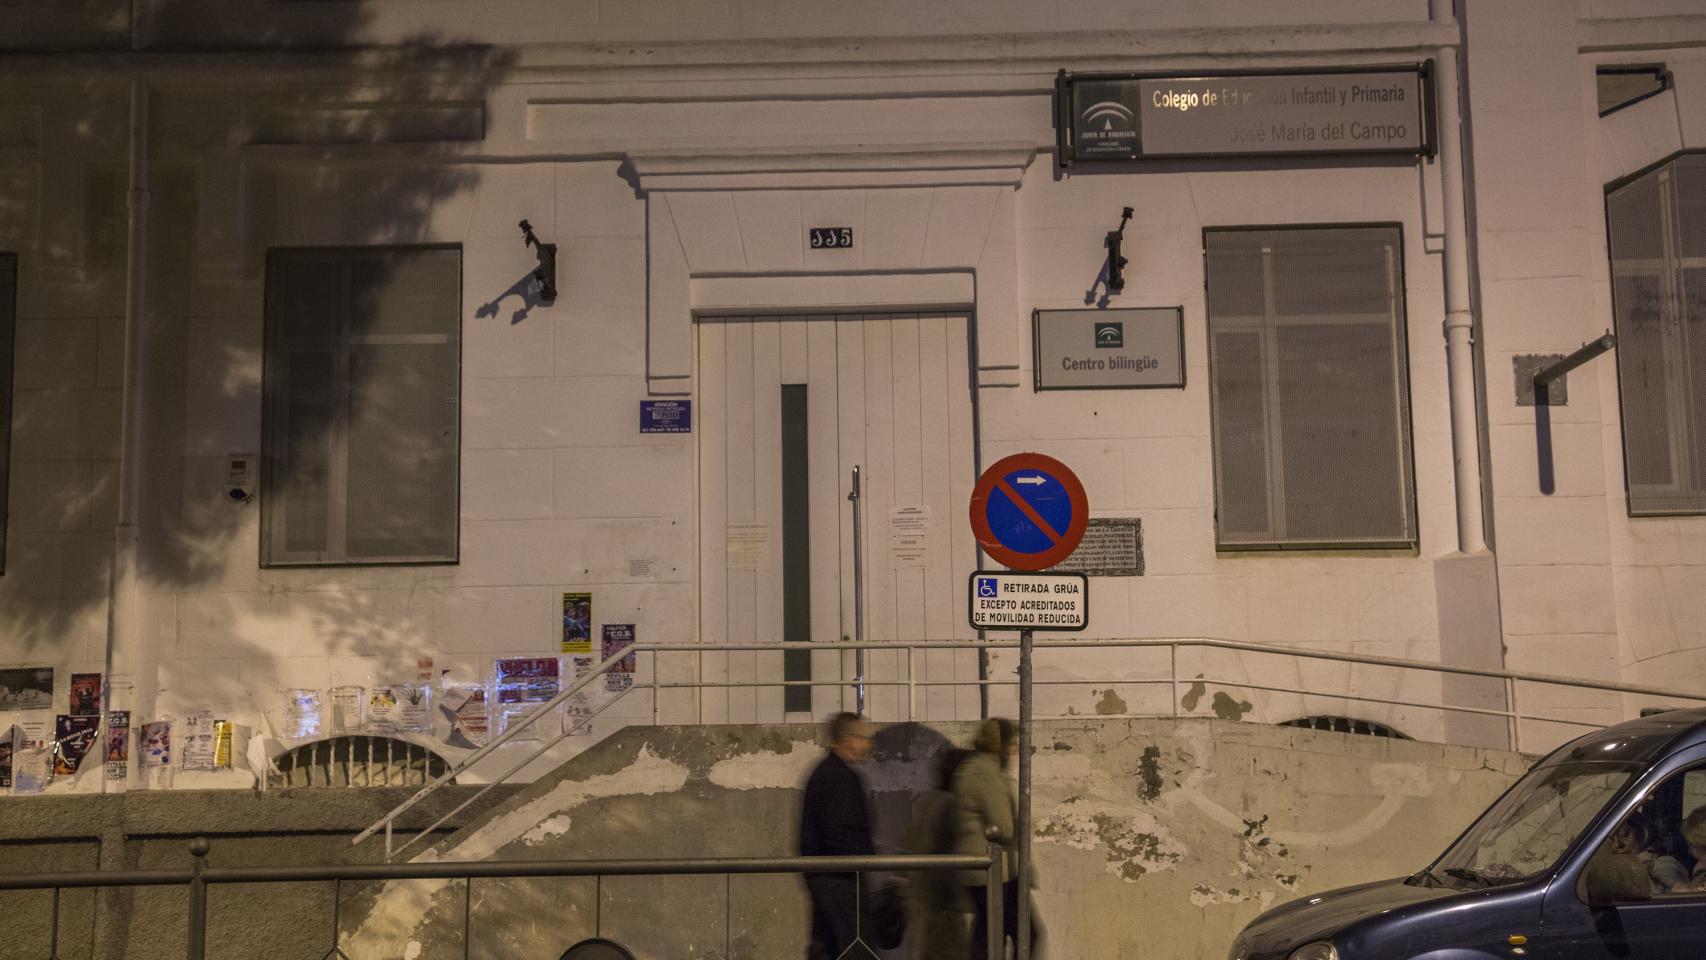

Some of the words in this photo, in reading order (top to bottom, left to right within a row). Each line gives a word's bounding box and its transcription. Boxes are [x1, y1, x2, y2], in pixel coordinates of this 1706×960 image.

[1153, 89, 1199, 111] Colegio
[1202, 89, 1217, 106] de
[1292, 86, 1336, 104] Infantil
[1340, 90, 1347, 107] y
[1352, 84, 1405, 102] Primaria
[1231, 122, 1265, 143] José
[1272, 122, 1315, 141] María
[1321, 123, 1344, 140] del
[1350, 121, 1406, 142] Campo
[1062, 356, 1105, 371] Centro
[1109, 355, 1159, 372] bilingüe
[1003, 583, 1050, 594] RETIRADA
[1054, 582, 1079, 594] GRÚA
[980, 600, 1017, 610] EXCEPTO
[1020, 601, 1076, 611] ACREDITADOS
[975, 612, 986, 622] DE
[989, 612, 1035, 623] MOVILIDAD
[1039, 613, 1081, 624] REDUCIDA
